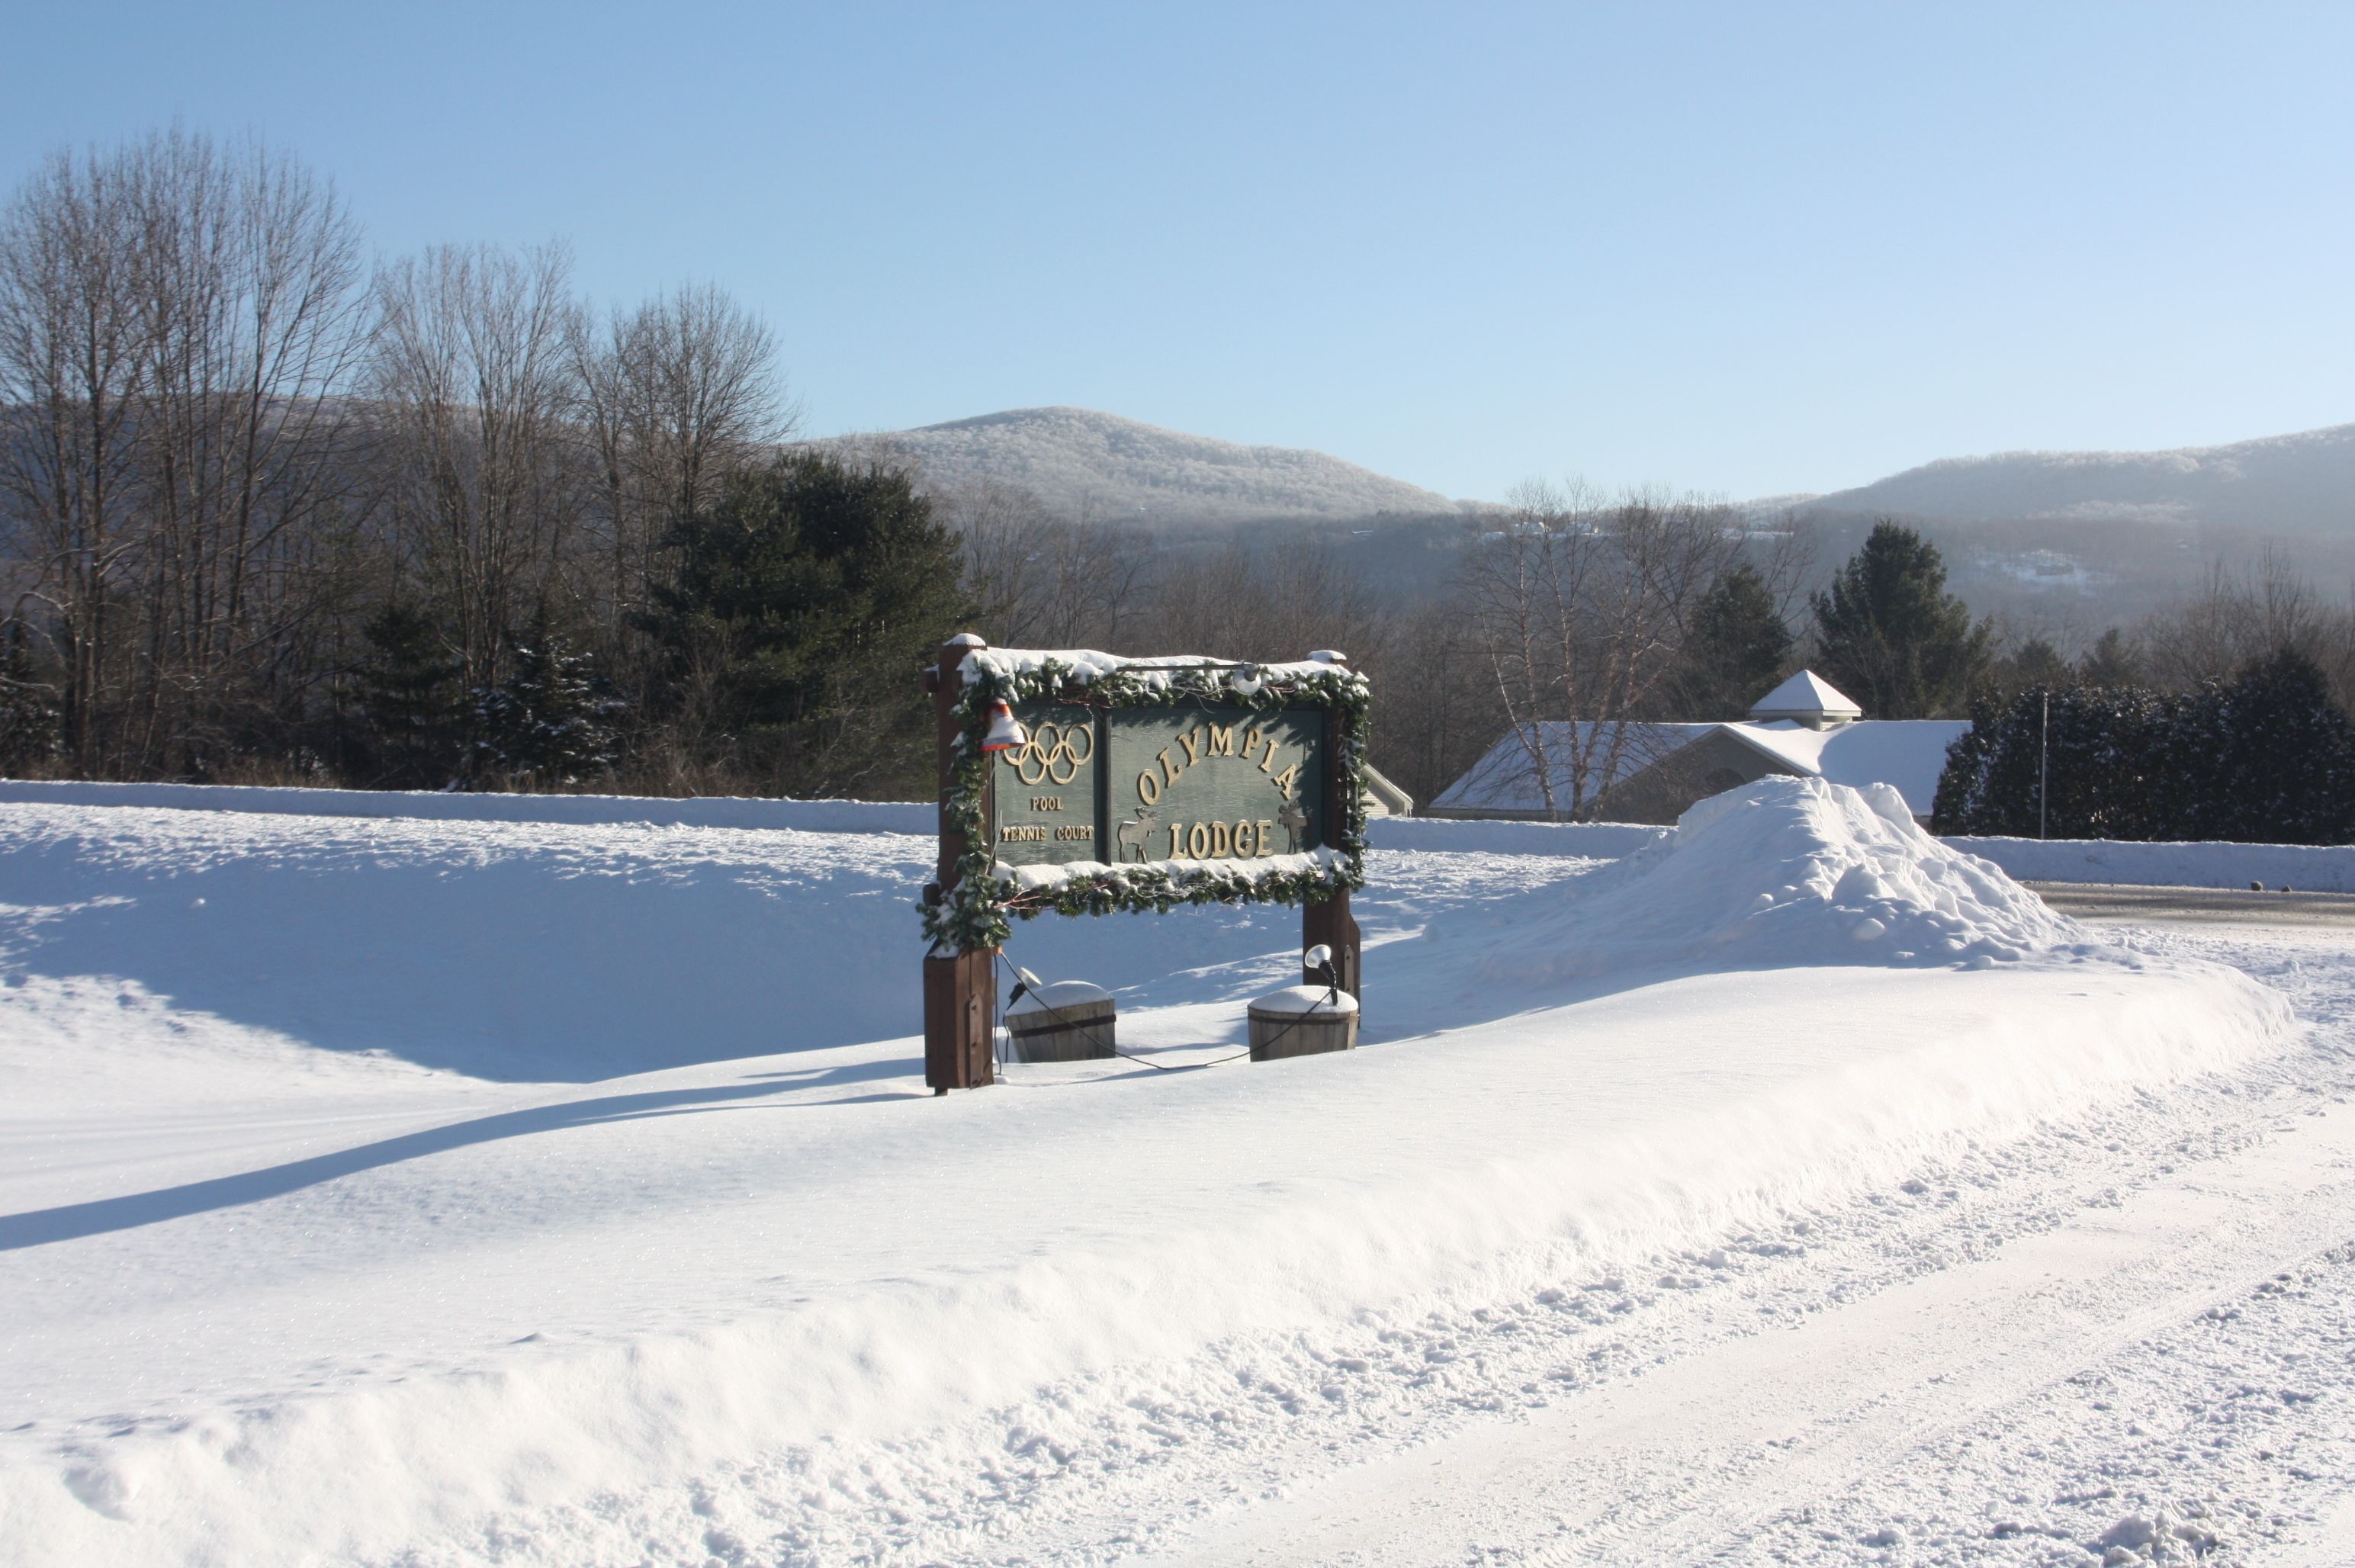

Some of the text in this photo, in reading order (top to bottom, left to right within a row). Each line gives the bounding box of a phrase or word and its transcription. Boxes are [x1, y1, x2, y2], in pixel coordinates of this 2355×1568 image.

[1138, 721, 1297, 805] OLYMPIA
[1032, 796, 1065, 811] POOL
[1002, 825, 1094, 842] TENNIS COURT
[1170, 820, 1274, 860] LODGE
